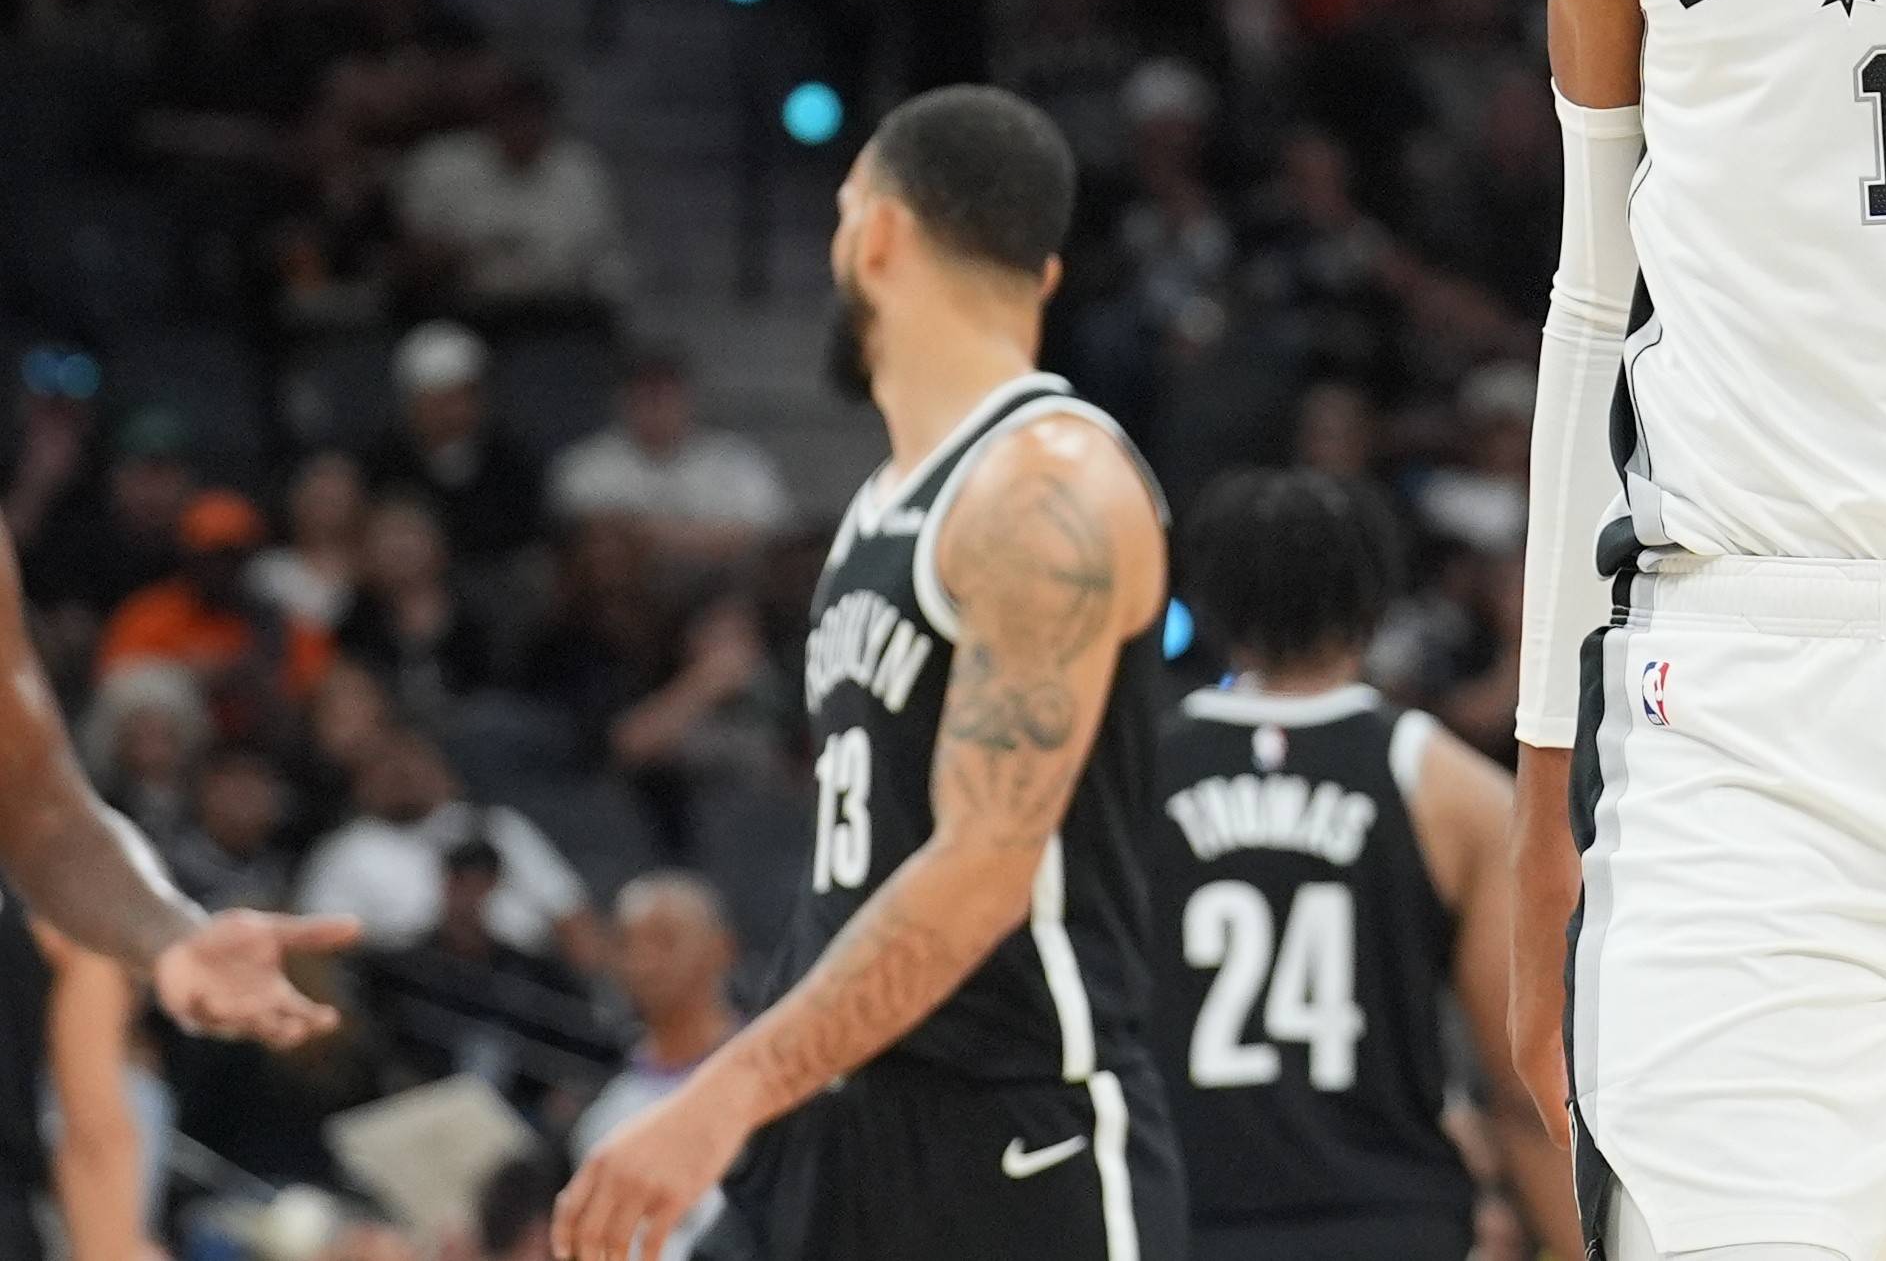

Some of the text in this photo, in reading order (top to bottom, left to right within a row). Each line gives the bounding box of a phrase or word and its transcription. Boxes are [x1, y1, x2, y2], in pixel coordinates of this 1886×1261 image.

[813, 726, 872, 894] 13
[1165, 773, 1378, 866] THOMAS
[1182, 880, 1364, 1091] 24
